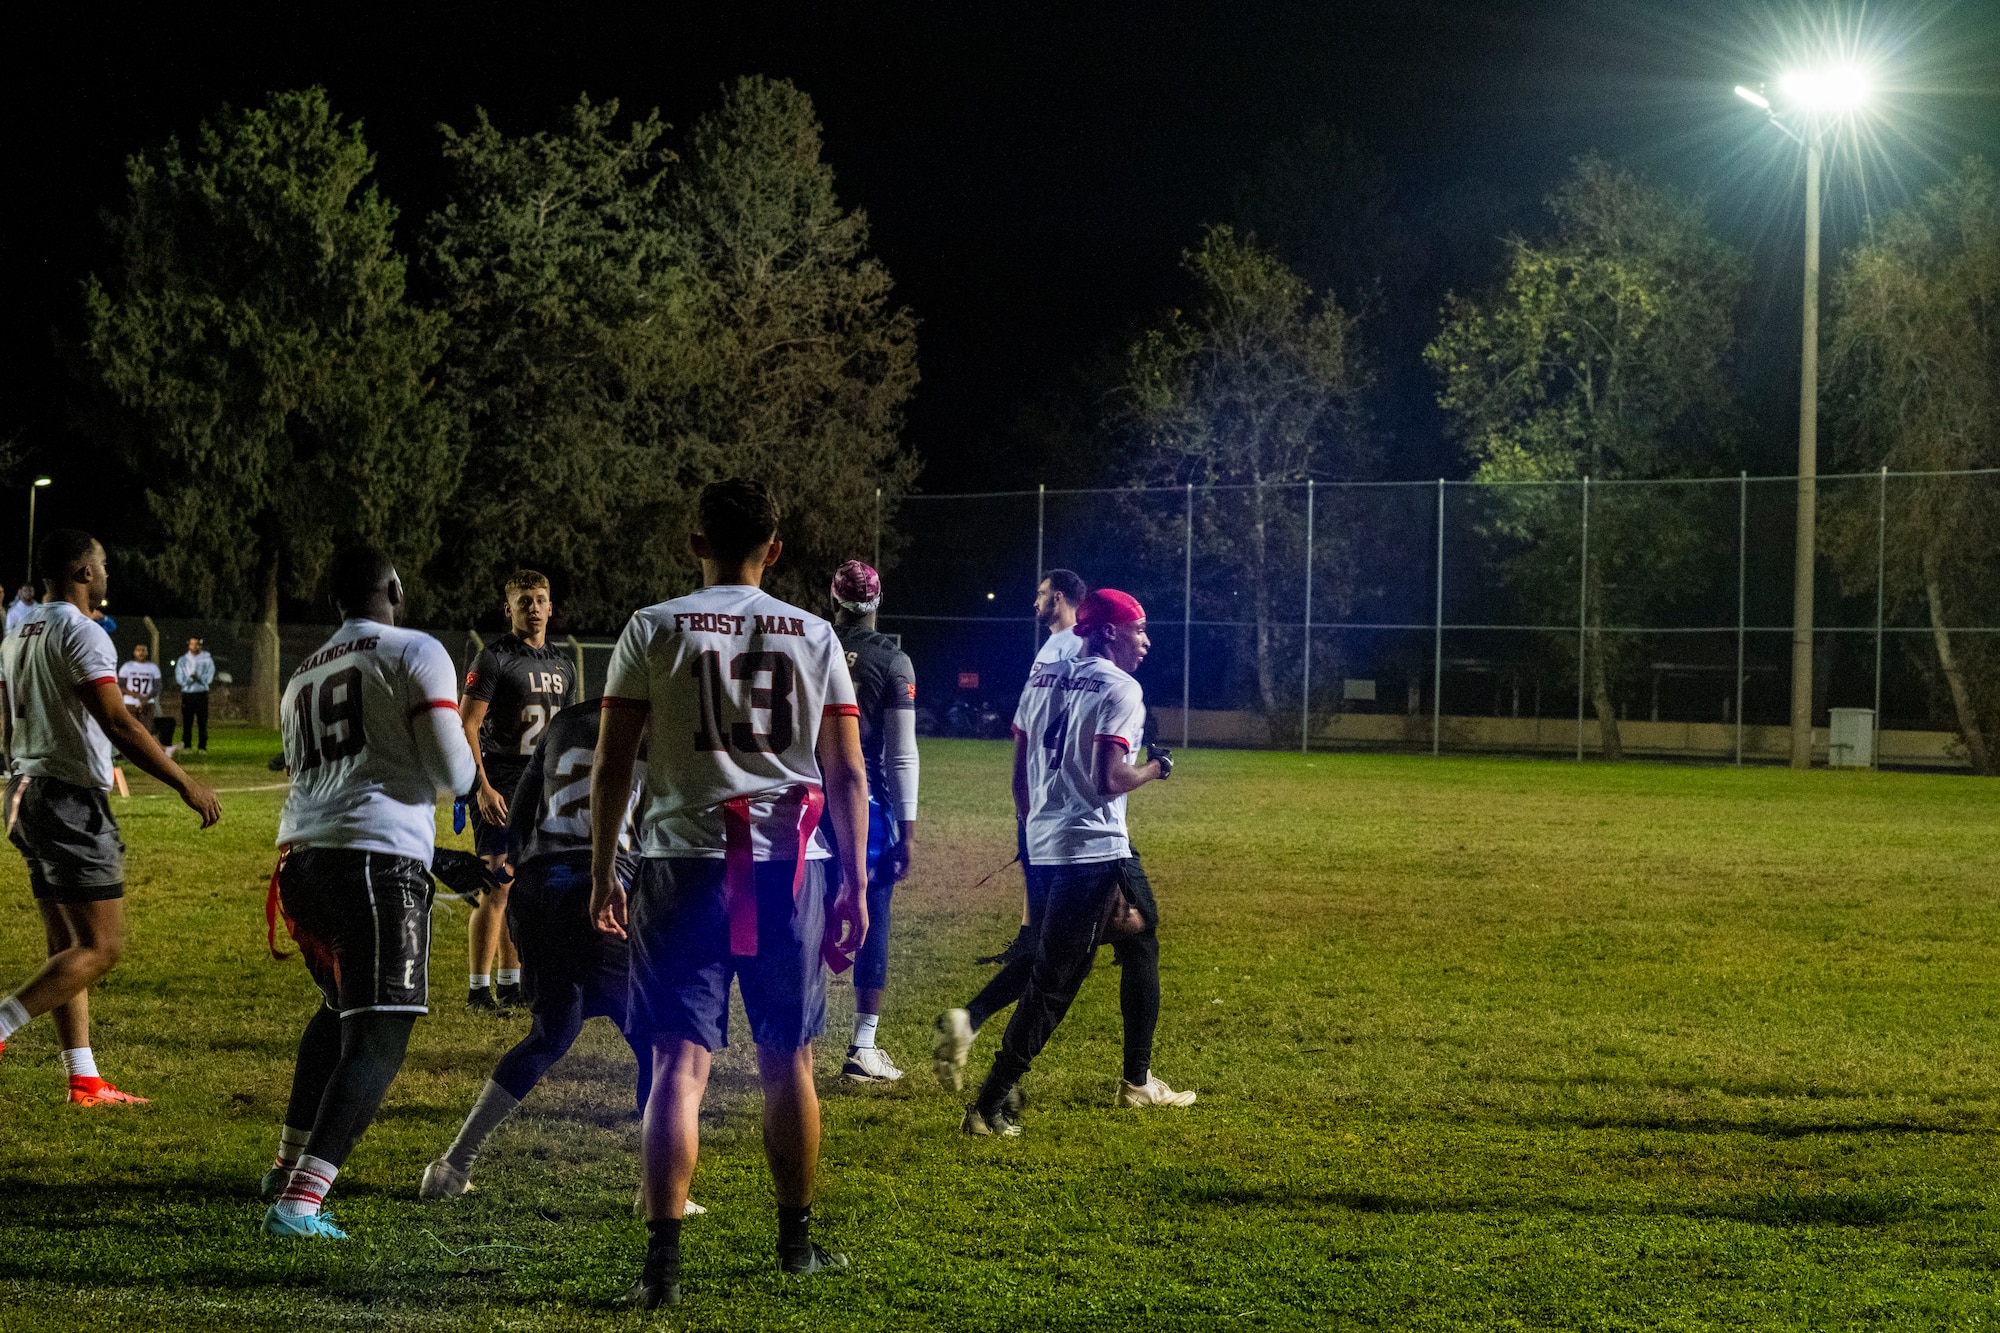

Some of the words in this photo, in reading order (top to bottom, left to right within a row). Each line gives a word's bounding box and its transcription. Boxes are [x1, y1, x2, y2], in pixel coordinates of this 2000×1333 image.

[674, 612, 745, 635] FROST
[753, 614, 806, 637] MAN
[132, 677, 150, 694] 97
[528, 672, 563, 694] LRS
[691, 650, 794, 754] 13
[295, 664, 366, 773] 19
[520, 704, 560, 756] 2
